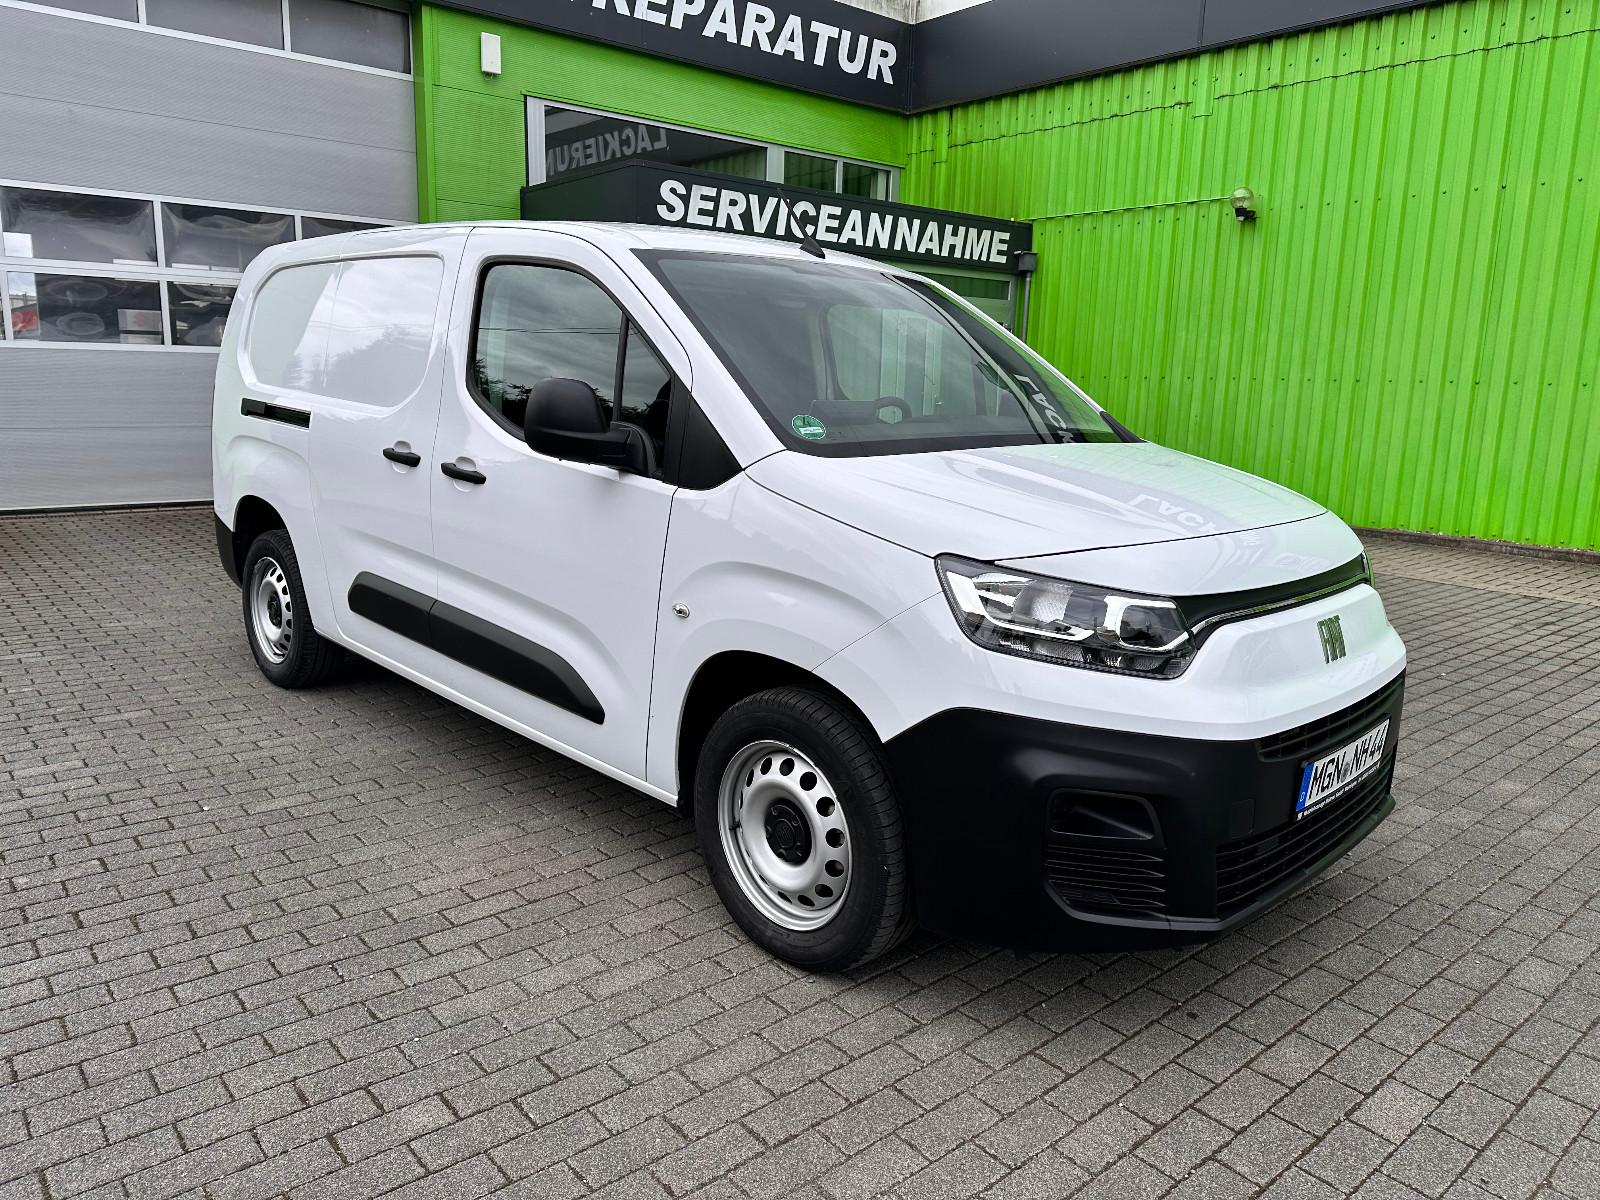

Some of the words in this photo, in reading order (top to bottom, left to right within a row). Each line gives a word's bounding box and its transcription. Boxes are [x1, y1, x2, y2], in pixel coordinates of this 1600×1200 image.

[591, 0, 897, 85] EPARATUR
[656, 179, 1011, 265] SERVICEANNAHME
[1317, 614, 1347, 665] FIAT
[1309, 751, 1347, 799] MGN
